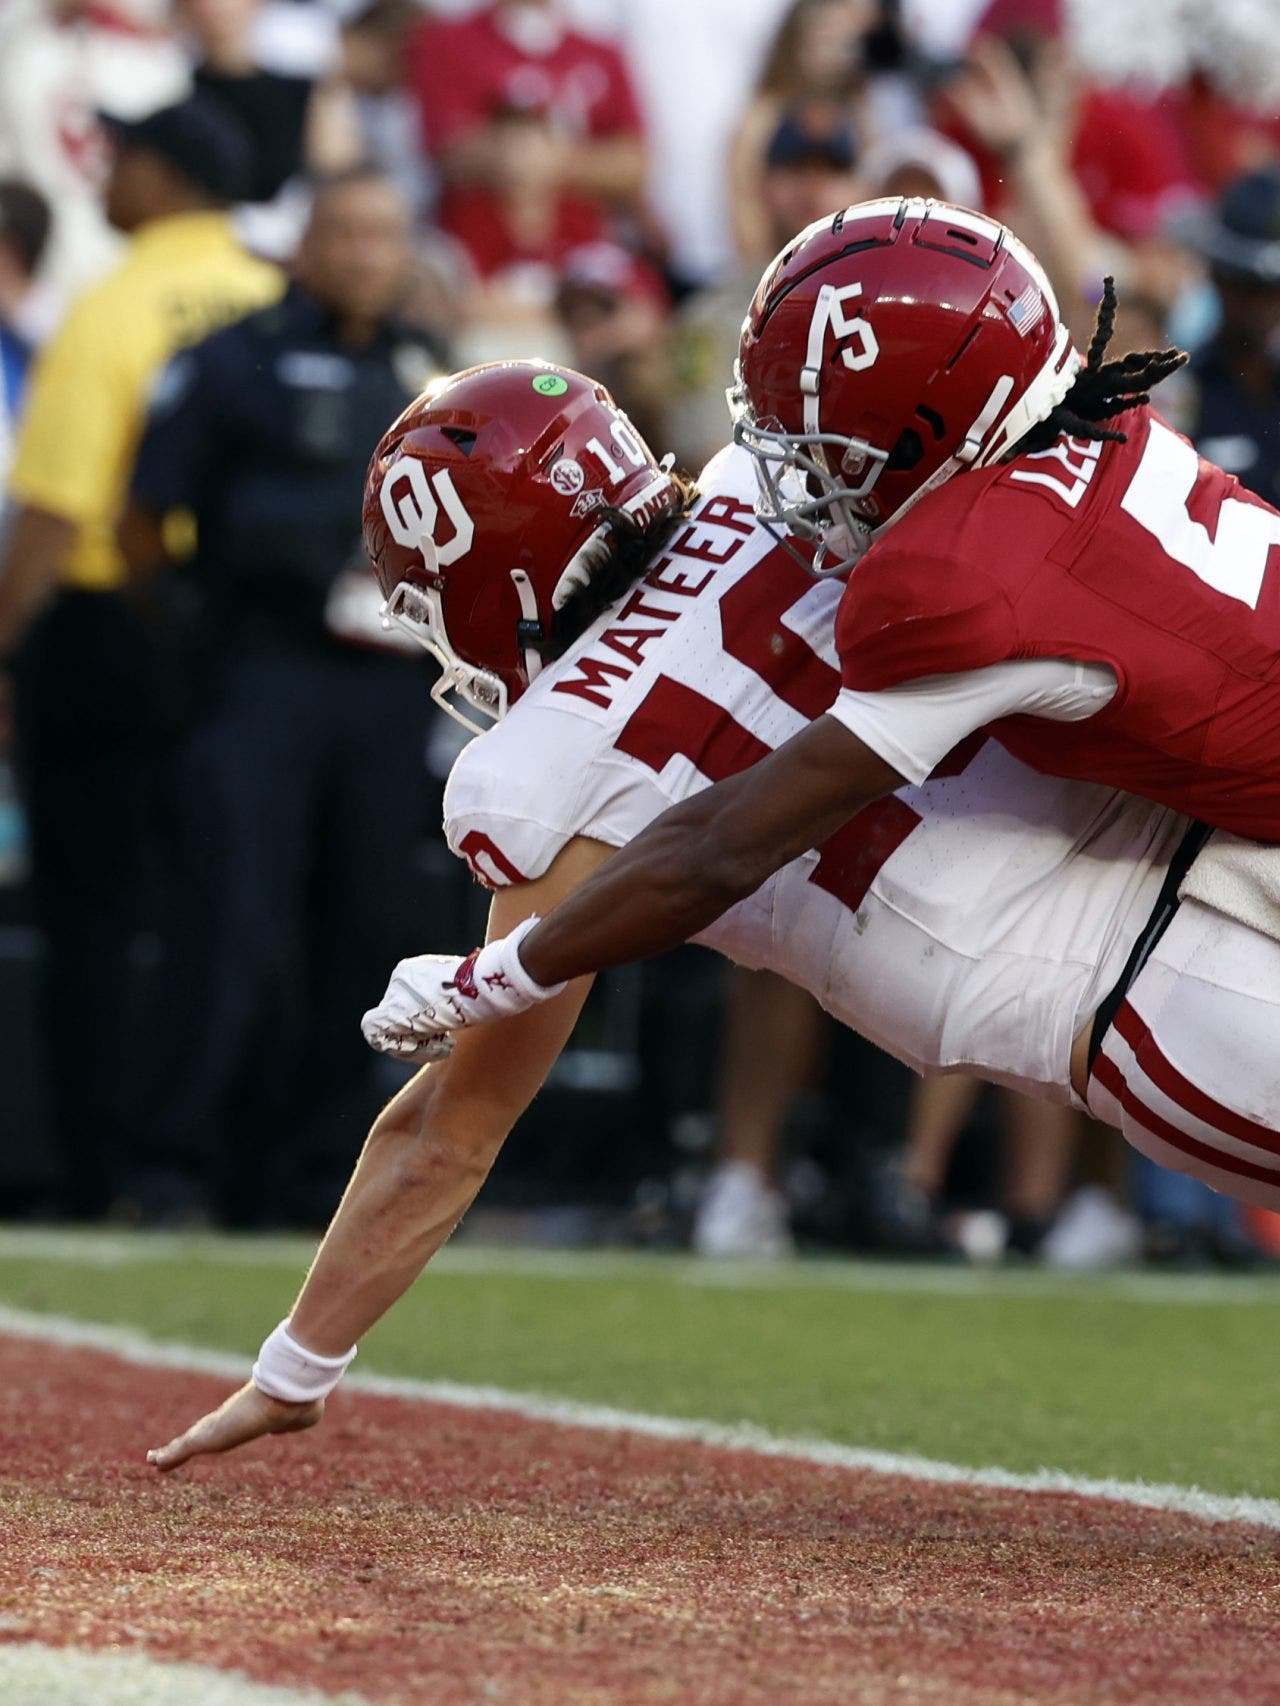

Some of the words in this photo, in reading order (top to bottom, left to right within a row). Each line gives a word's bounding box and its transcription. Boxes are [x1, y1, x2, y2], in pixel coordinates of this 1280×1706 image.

[829, 282, 880, 371] 5
[585, 420, 647, 486] 10
[380, 455, 475, 566] OU
[551, 495, 757, 710] MATEER
